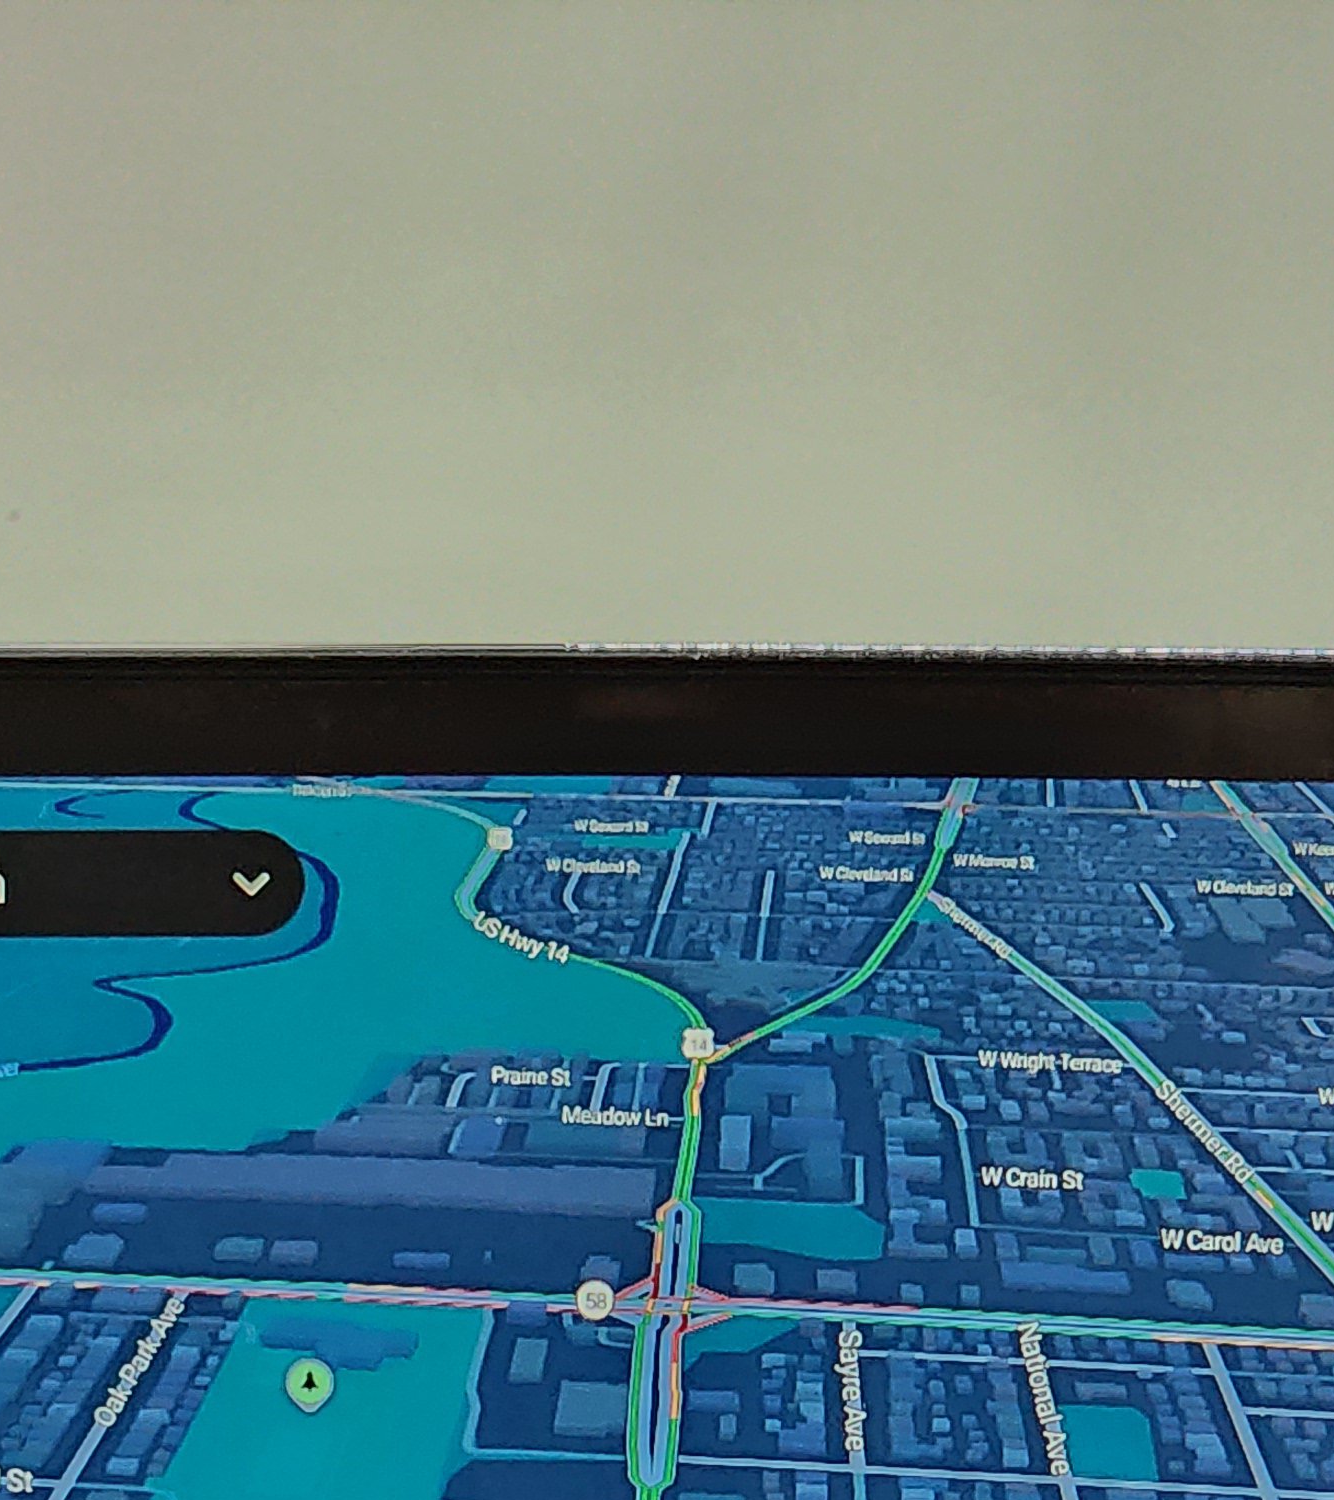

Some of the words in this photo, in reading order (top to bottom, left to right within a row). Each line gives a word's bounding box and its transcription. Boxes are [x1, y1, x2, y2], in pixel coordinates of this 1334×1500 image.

[562, 859, 626, 874] Cleveland
[835, 866, 898, 882] Cleveland
[472, 911, 503, 938] US
[498, 924, 545, 959] Hwy
[545, 940, 571, 965] 14
[977, 1049, 999, 1068] W
[999, 1051, 1055, 1074] Wright
[1058, 1053, 1124, 1075] Terrace
[551, 1066, 572, 1087] St
[561, 1104, 643, 1125] Meadow
[645, 1107, 670, 1127] Ln
[1154, 1078, 1232, 1163] Shermer
[1222, 1149, 1254, 1185] Rd
[980, 1166, 1004, 1188] W
[1005, 1167, 1059, 1190] Crain
[1061, 1168, 1086, 1191] St
[1160, 1227, 1184, 1250] W
[1185, 1229, 1242, 1253] Carol
[1244, 1232, 1285, 1255] Ave
[585, 1292, 607, 1308] 58
[93, 1387, 133, 1427] Oak
[118, 1337, 162, 1386] Park
[149, 1296, 186, 1339] Ave
[833, 1329, 864, 1402] Sayre
[1017, 1320, 1064, 1427] National
[1042, 1429, 1071, 1477] Ave
[843, 1402, 868, 1452] Ave
[5, 1468, 35, 1493] St
